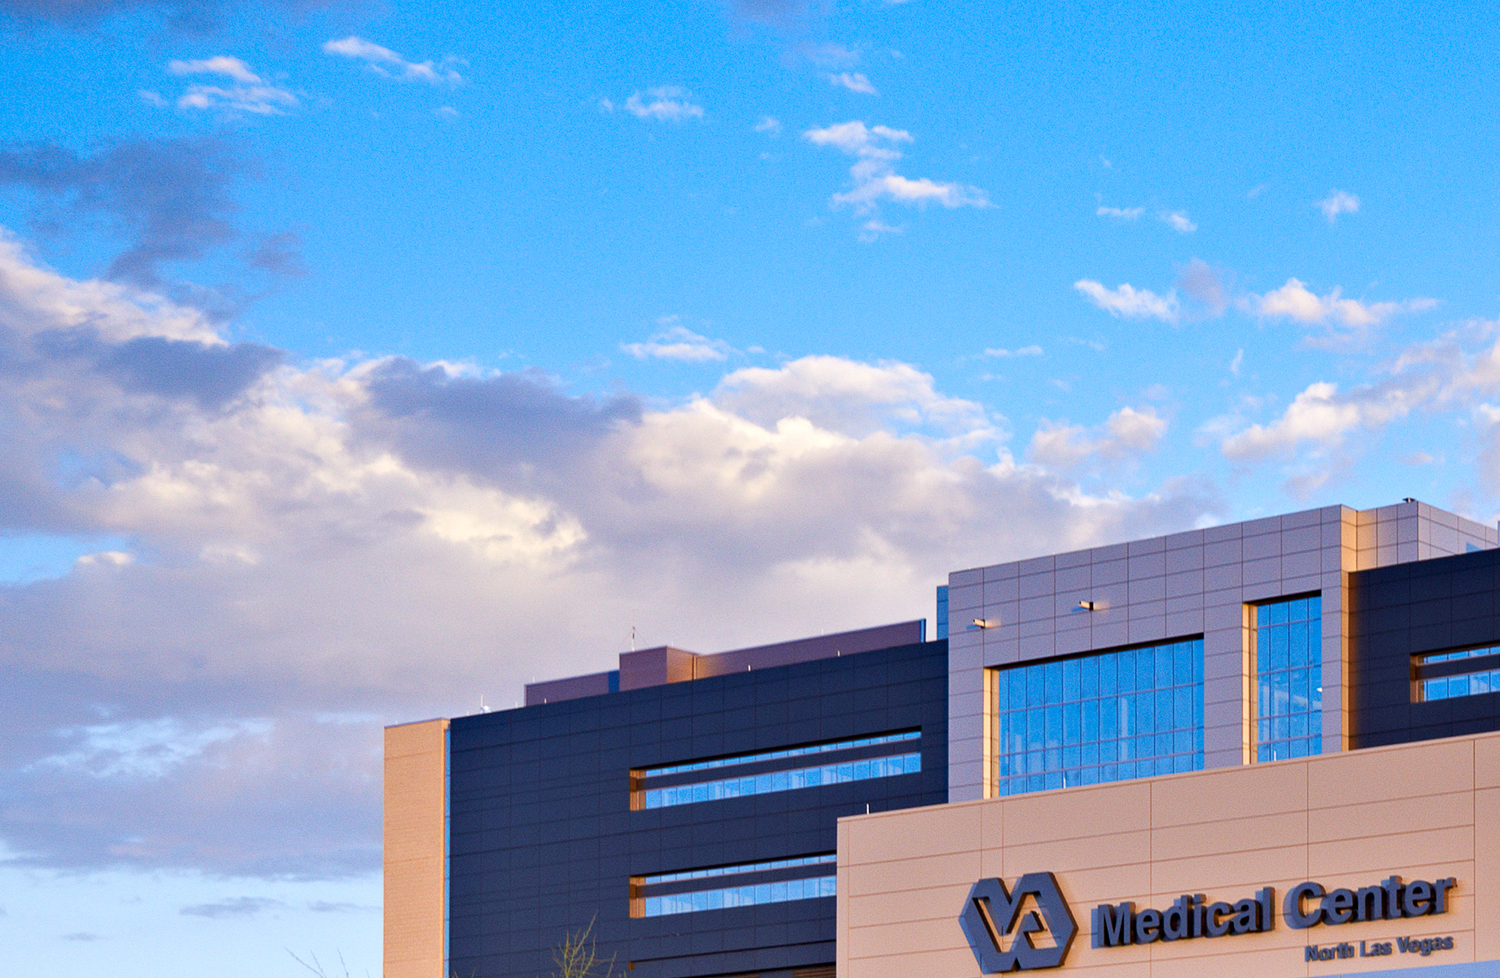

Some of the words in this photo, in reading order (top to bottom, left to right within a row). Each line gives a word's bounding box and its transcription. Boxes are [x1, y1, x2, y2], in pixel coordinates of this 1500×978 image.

[961, 871, 1078, 974] VA
[1094, 886, 1275, 949] Medical
[1285, 875, 1457, 928] Center
[1304, 943, 1354, 962] North
[1359, 940, 1392, 957] Las
[1396, 936, 1454, 957] Vegas
